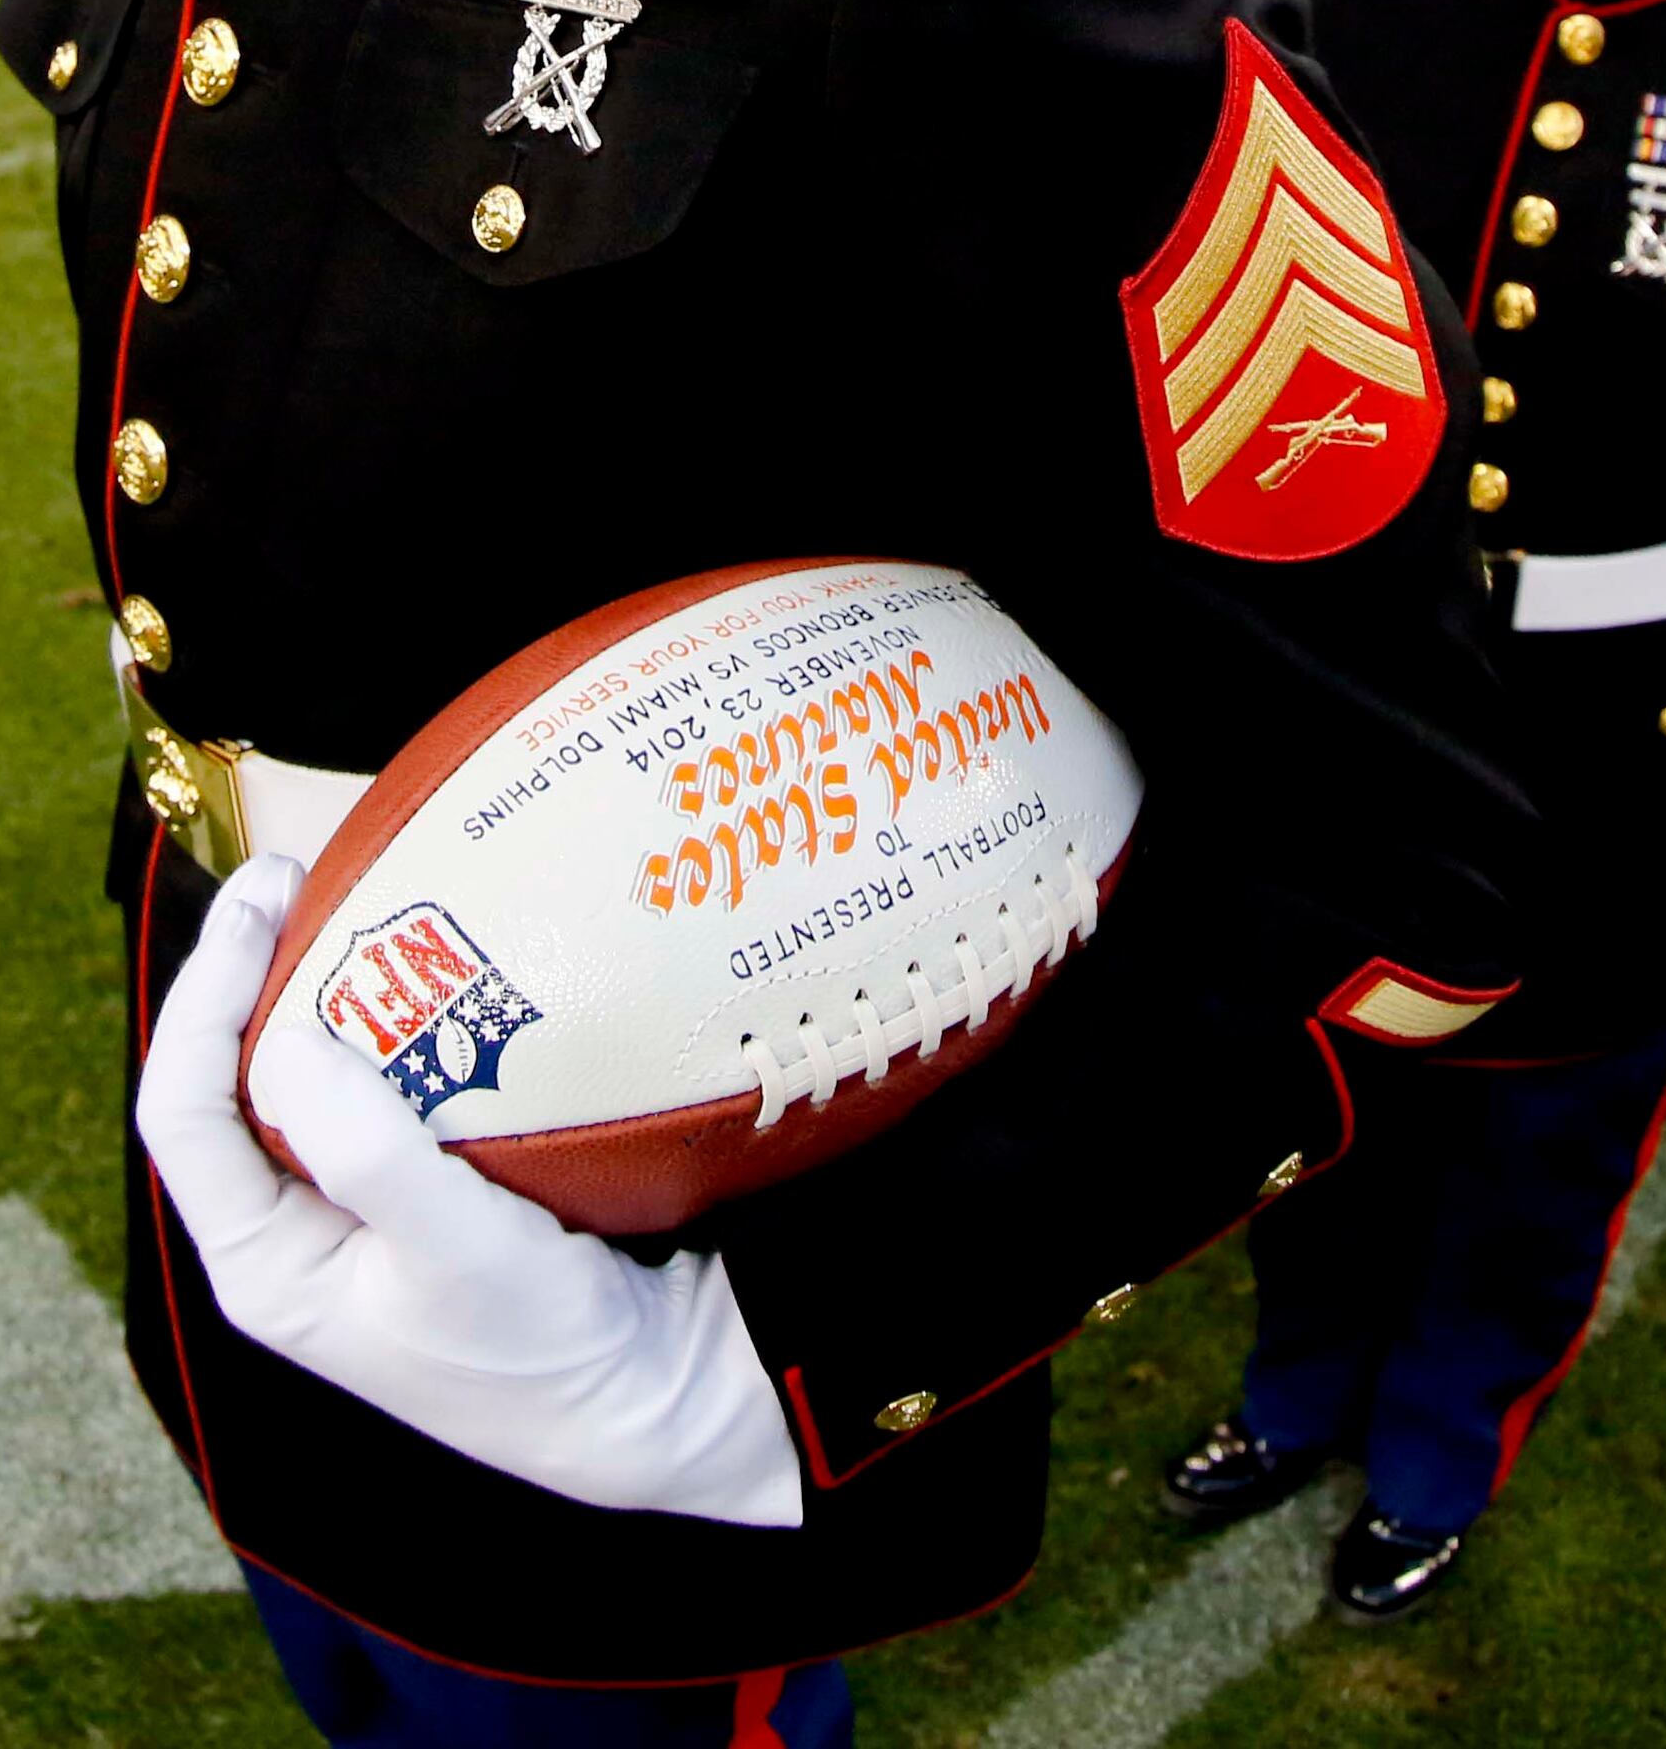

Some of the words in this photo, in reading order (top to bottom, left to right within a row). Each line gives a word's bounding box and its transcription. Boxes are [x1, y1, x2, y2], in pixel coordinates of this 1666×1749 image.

[761, 590, 815, 617] YOU
[810, 573, 900, 598] THANK
[873, 585, 967, 613] DENVER
[703, 607, 763, 639] FOR
[753, 603, 875, 658] BRONCOS
[628, 634, 711, 677] YOUR
[708, 654, 750, 681] VS
[765, 624, 923, 698] NOVEMBER
[514, 672, 630, 752] SERVICE
[606, 672, 703, 735] MIAMI
[662, 649, 935, 819] Marines
[704, 688, 763, 721] 23,
[625, 714, 707, 773] 2014
[868, 672, 1051, 820] United
[463, 731, 604, 841] DOLPHINS
[634, 763, 859, 916] States
[875, 822, 913, 857] TO
[923, 790, 1047, 879] FOOTBALL
[729, 866, 915, 980] PRESENTED
[326, 916, 478, 1056] NFL
